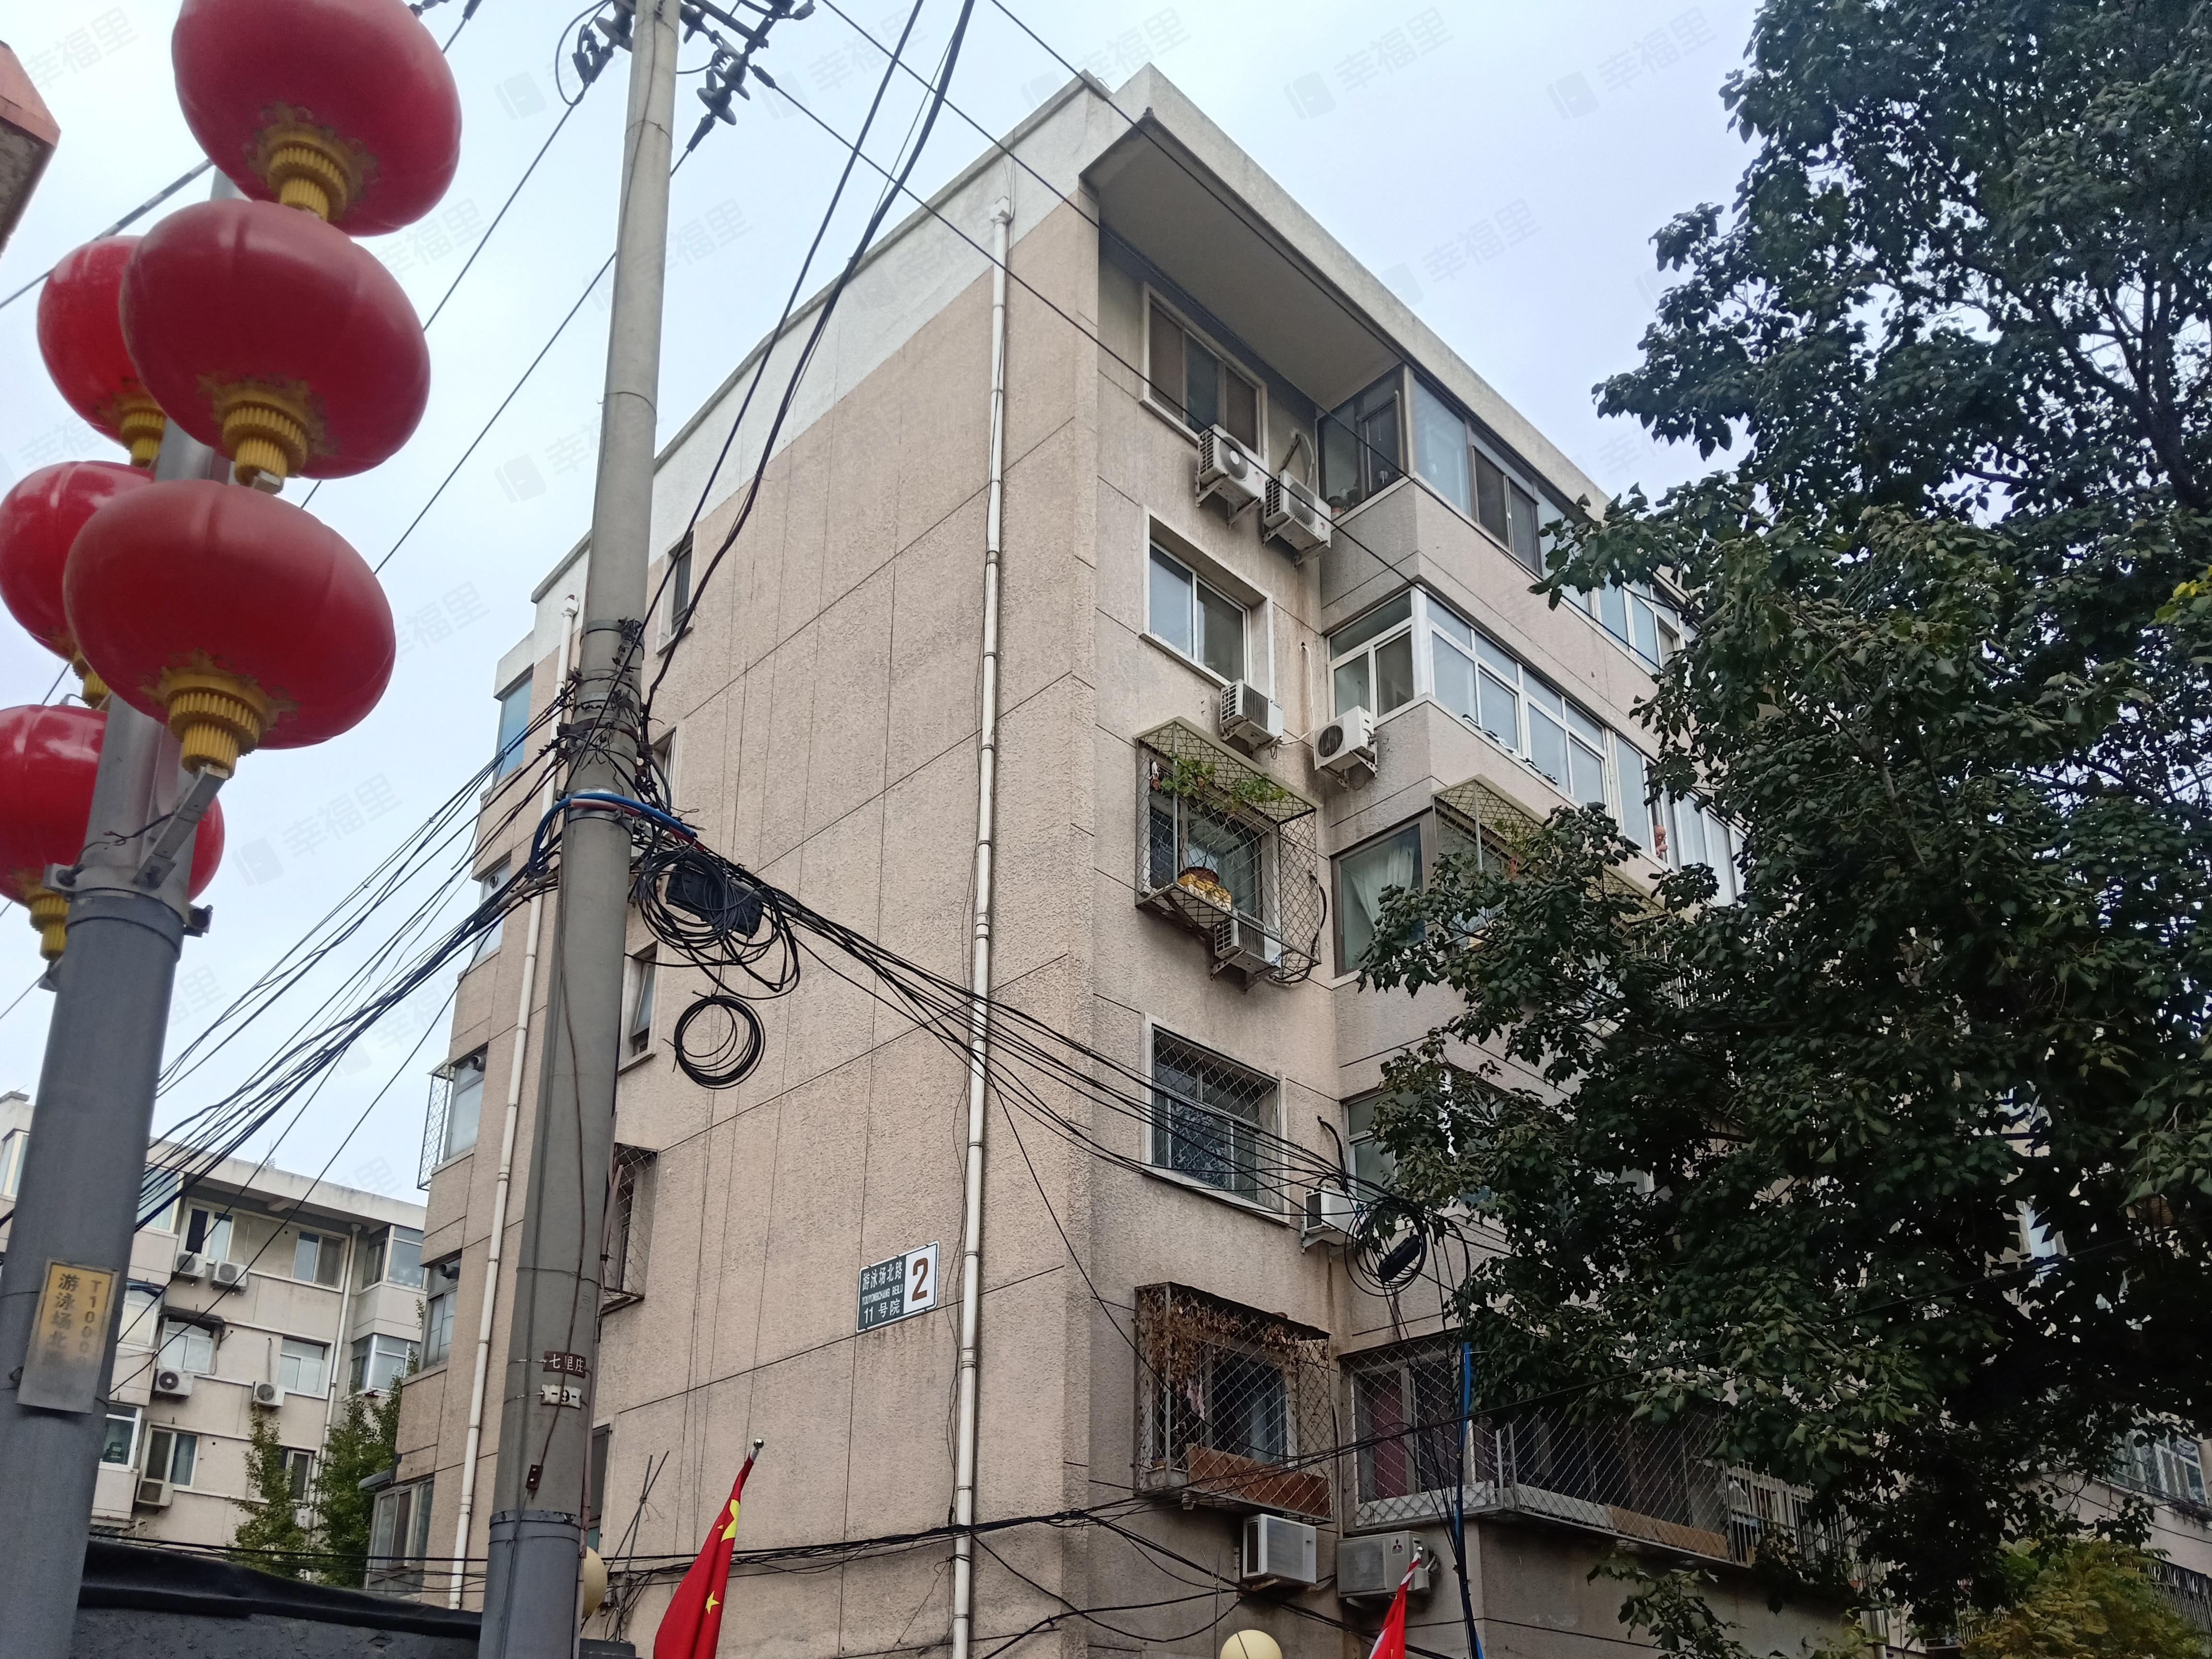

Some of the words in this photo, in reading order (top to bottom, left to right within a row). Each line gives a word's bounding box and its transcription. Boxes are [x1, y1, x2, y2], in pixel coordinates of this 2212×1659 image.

[862, 1260, 902, 1291] 游泳场北路
[912, 1257, 928, 1302] 2
[862, 1288, 890, 1306] YOUYONGCHANG
[892, 1283, 903, 1296] BEILU
[46, 1273, 81, 1366] 游泳场北
[549, 1354, 584, 1373] 七里庄
